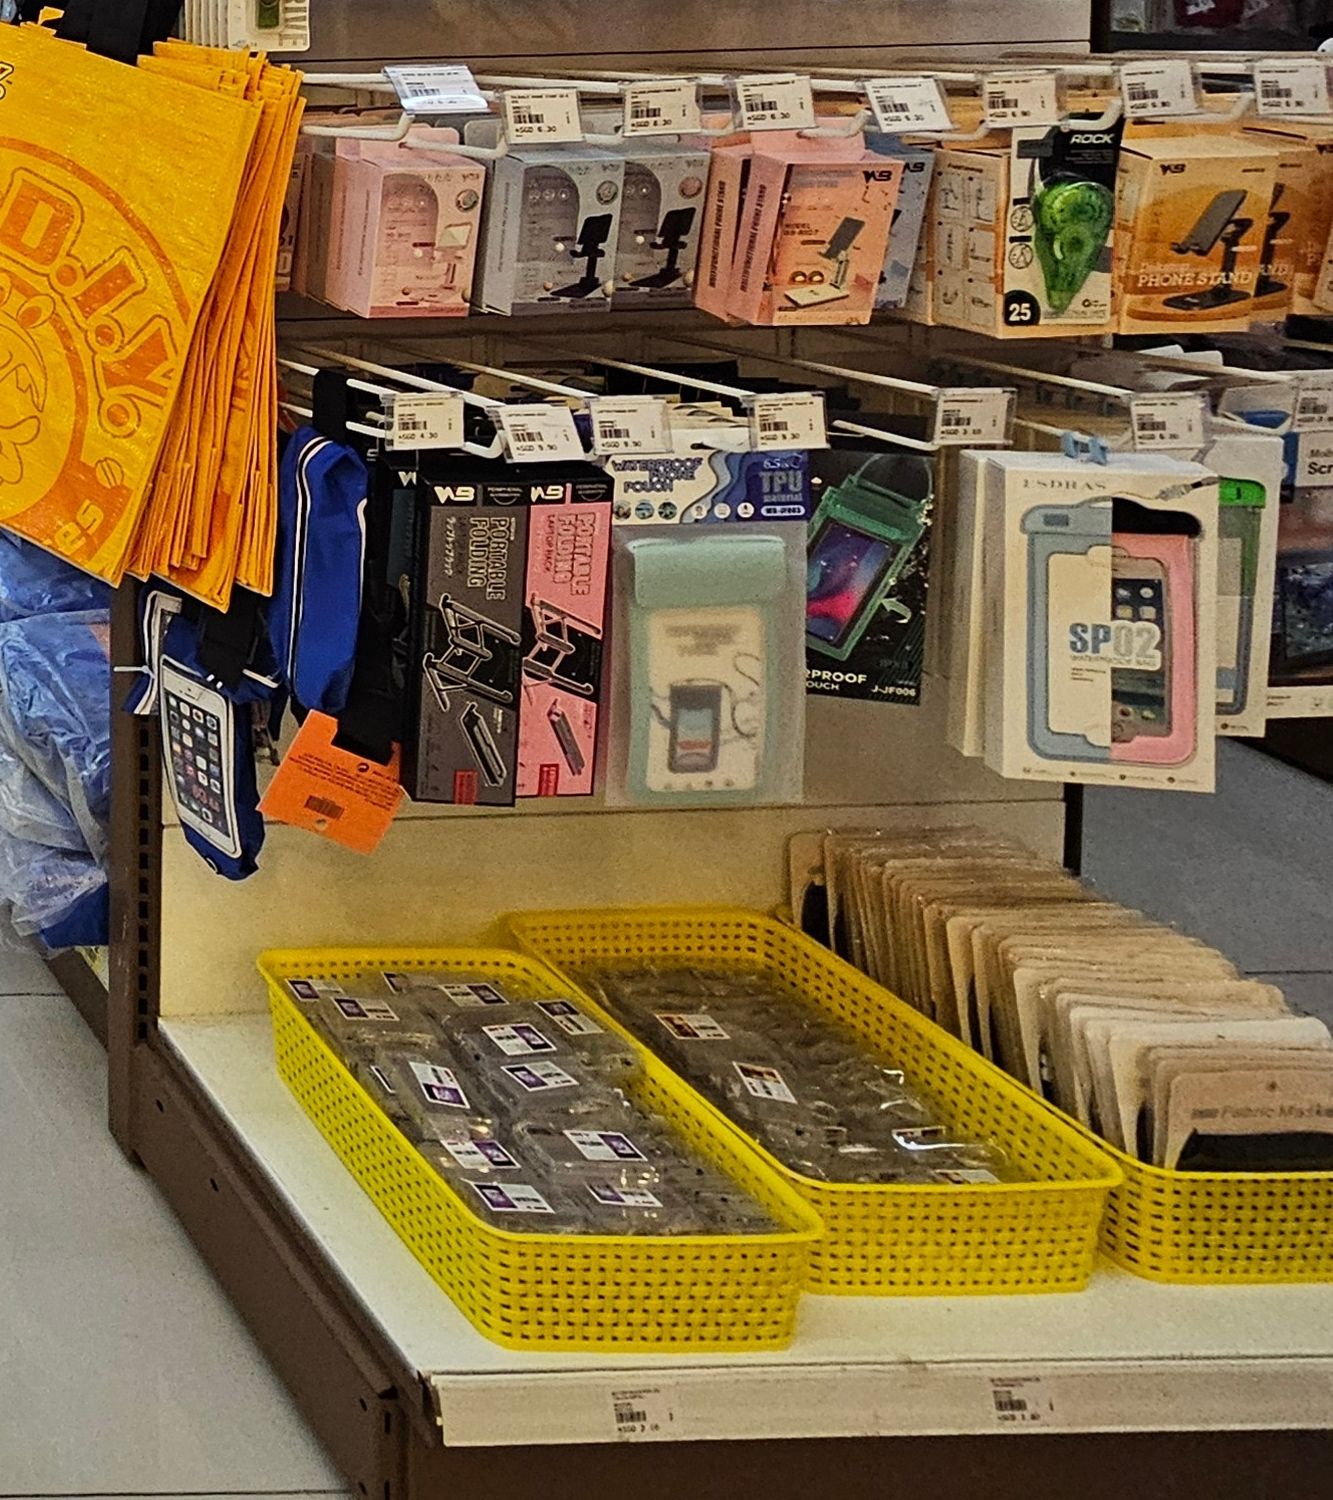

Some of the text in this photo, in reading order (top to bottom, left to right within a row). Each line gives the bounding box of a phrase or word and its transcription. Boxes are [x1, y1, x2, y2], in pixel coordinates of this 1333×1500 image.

[1069, 133, 1115, 145] ROCK
[1137, 271, 1254, 288] PHONE STAND
[1008, 303, 1032, 322] 25
[611, 457, 704, 472] WATERPROOF
[623, 478, 674, 493] POUCH
[760, 471, 803, 493] TPU
[466, 516, 490, 588] FOLDING
[486, 516, 510, 601] PORTABLE
[553, 512, 575, 584] FOLDING
[569, 511, 596, 597] PORTABLE
[1068, 621, 1162, 658] SP02
